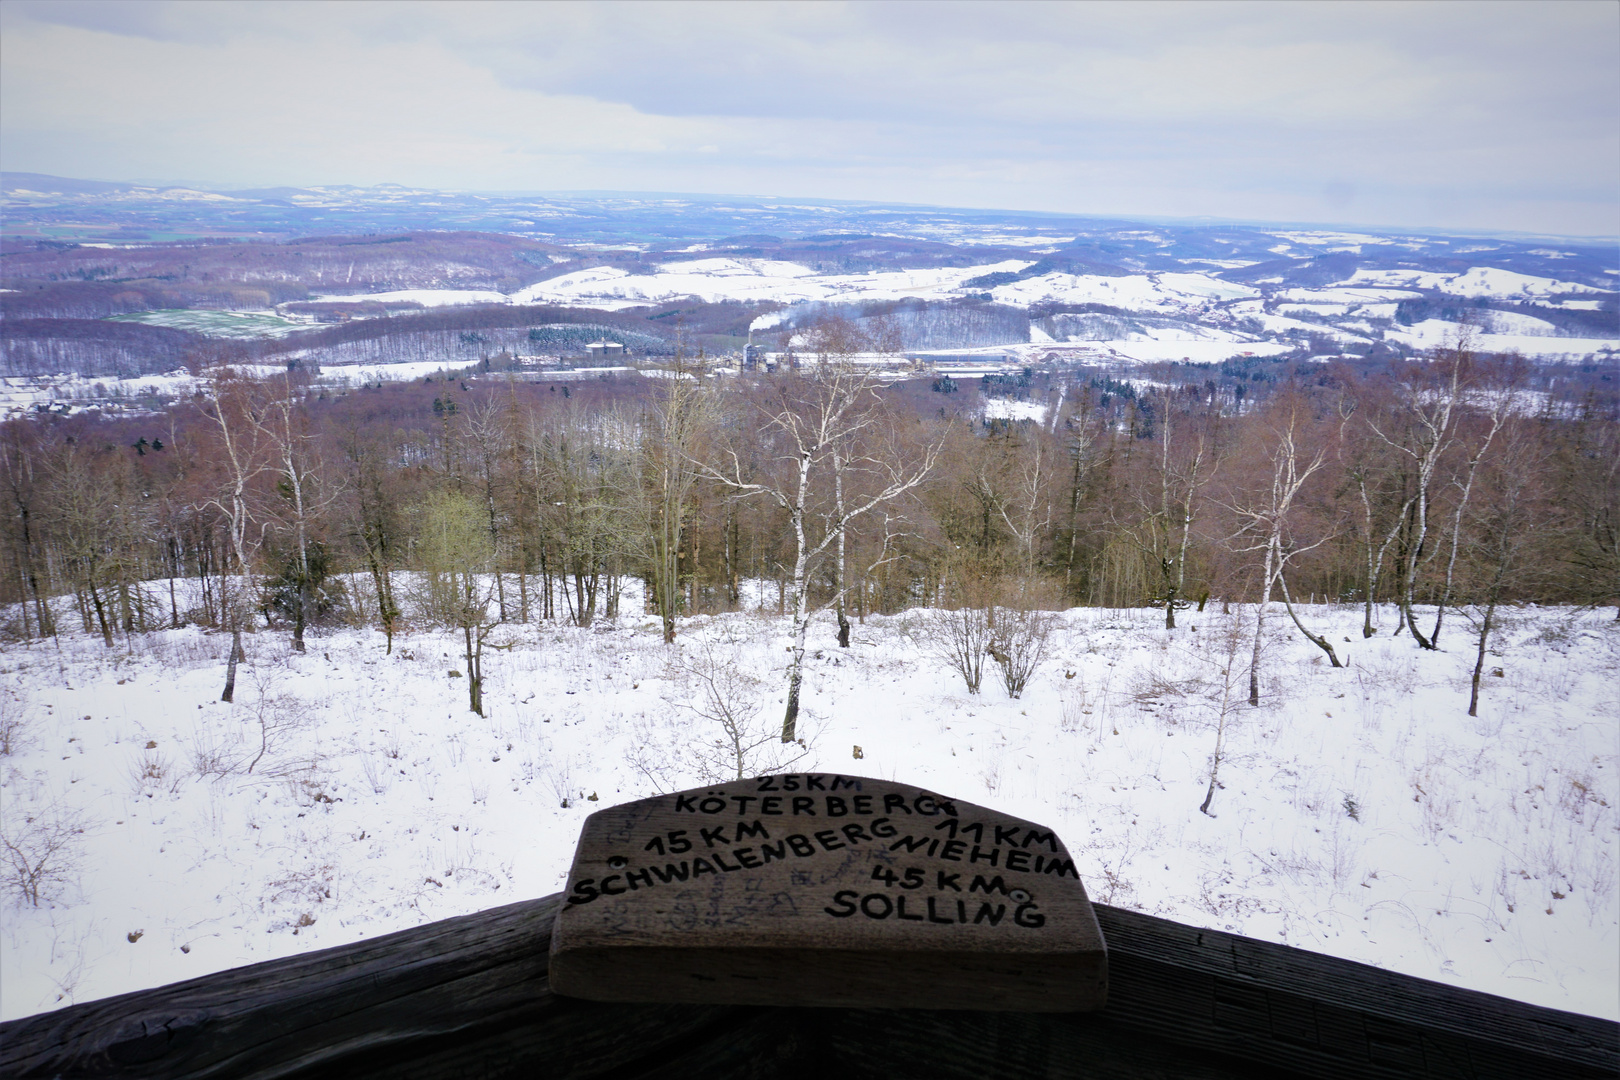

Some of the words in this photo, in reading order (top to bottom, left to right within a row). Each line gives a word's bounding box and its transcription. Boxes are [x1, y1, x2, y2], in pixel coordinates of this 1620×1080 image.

[676, 791, 948, 817] KÖTERBERG
[569, 817, 897, 905] SCHWALENBERG
[890, 835, 1080, 880] NIEHEIM
[824, 890, 1045, 928] SOLLING
